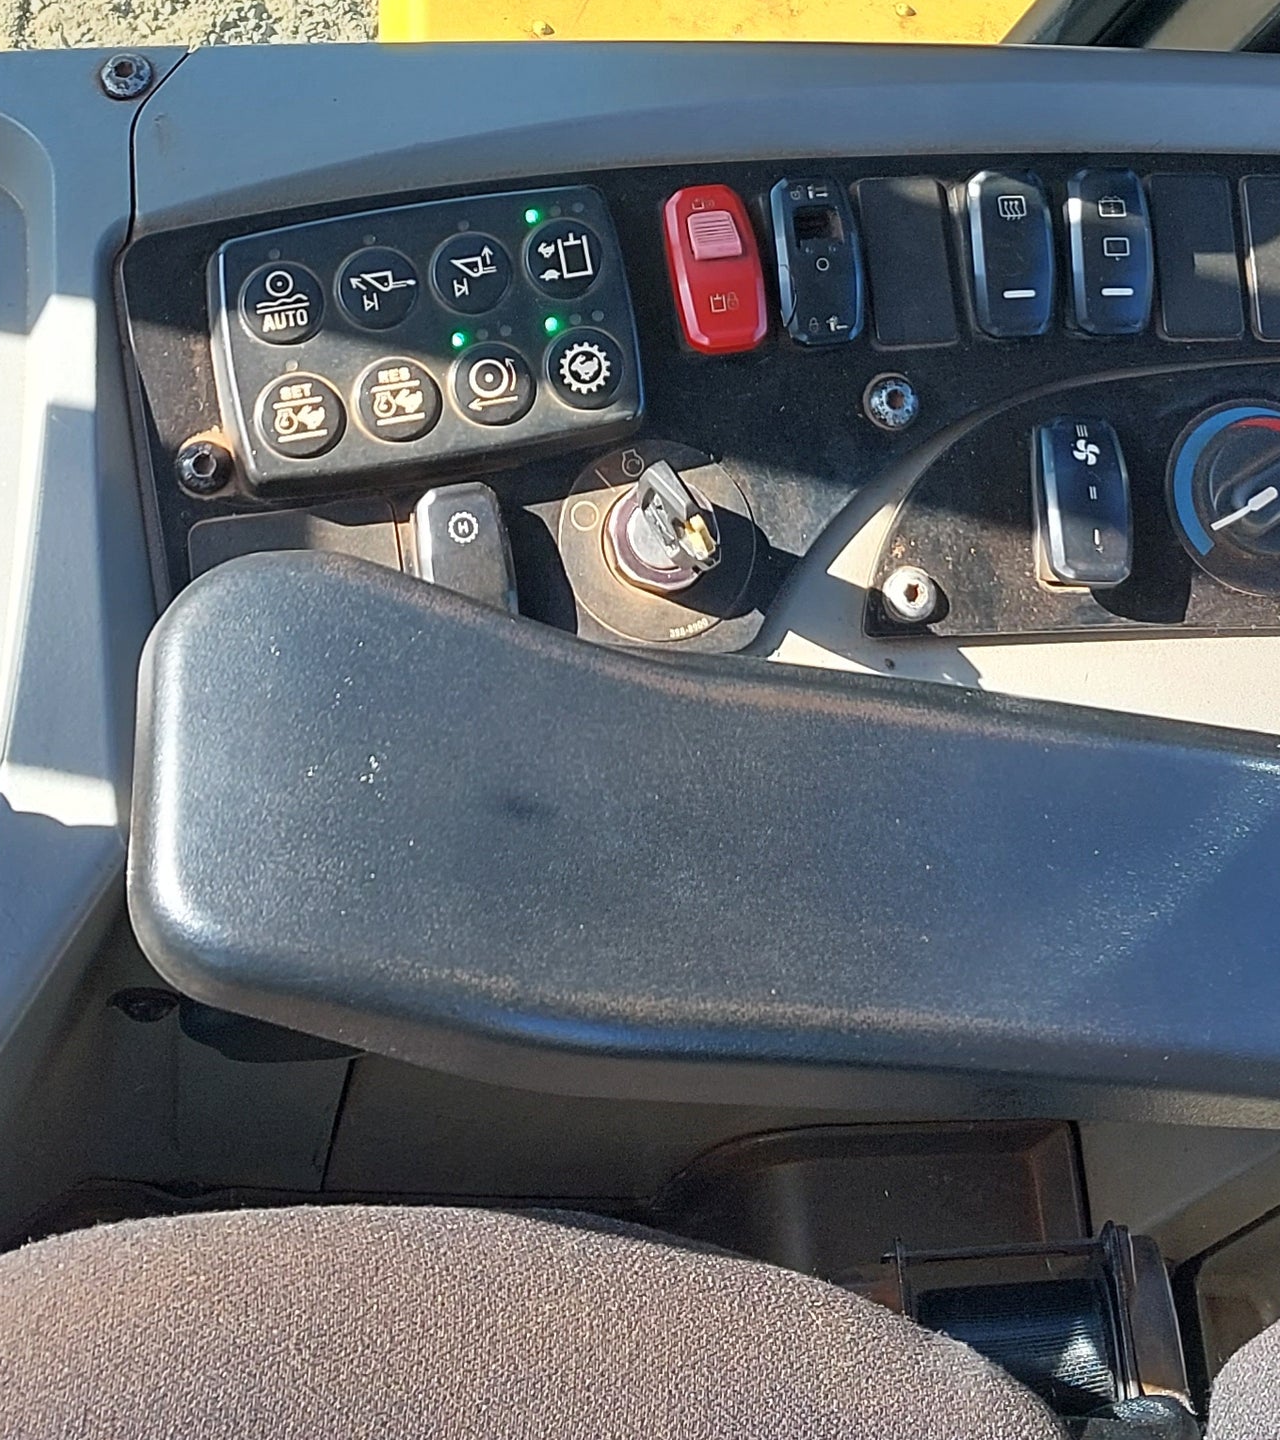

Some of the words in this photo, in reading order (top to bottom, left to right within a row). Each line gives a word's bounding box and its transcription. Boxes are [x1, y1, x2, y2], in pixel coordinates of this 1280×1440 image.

[262, 308, 309, 333] AUTO
[377, 366, 411, 384] RES
[278, 382, 313, 401] SET
